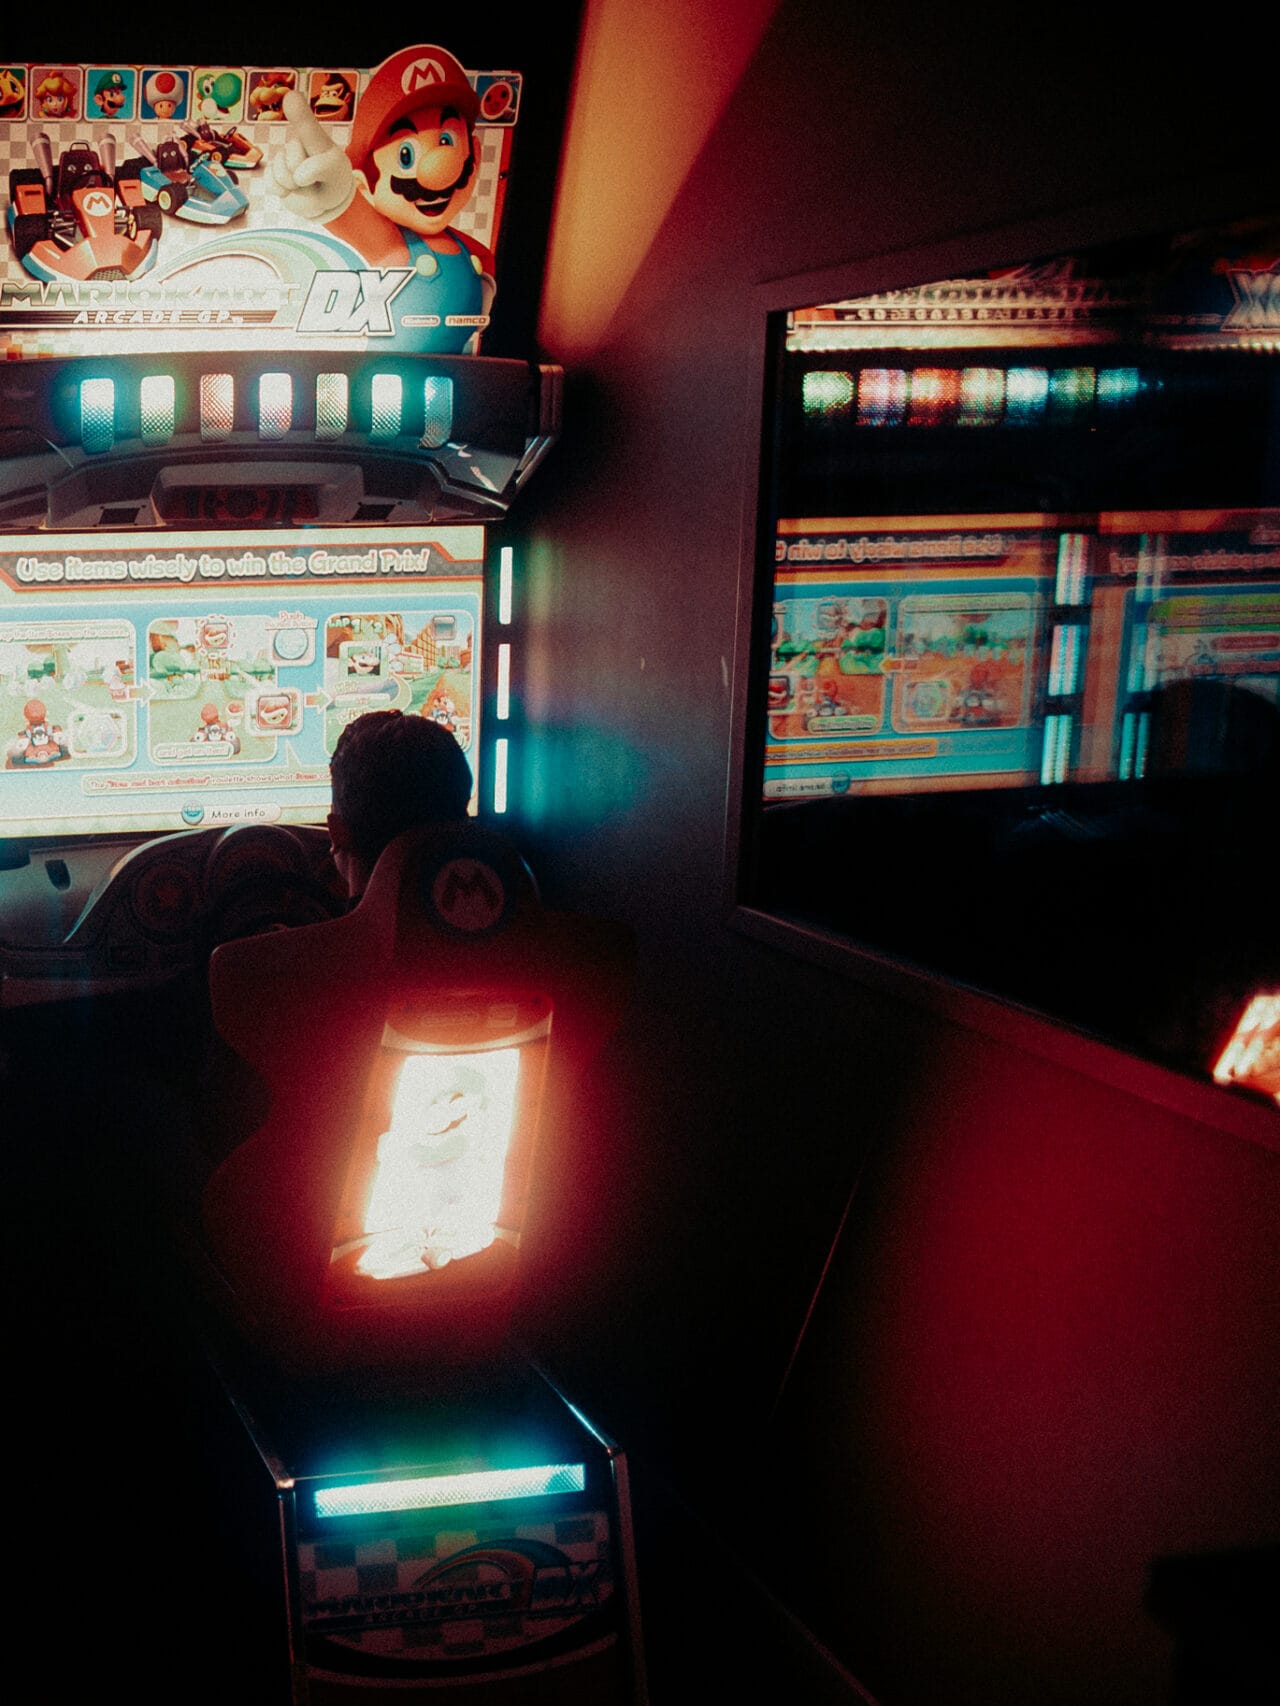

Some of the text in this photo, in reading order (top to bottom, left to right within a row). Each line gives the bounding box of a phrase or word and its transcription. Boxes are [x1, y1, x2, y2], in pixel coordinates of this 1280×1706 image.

[297, 268, 414, 335] DX
[73, 309, 180, 324] ARCADE
[448, 316, 487, 325] namco
[17, 549, 429, 583] Use items wisely to win the Grand Prix!
[211, 808, 266, 820] More info
